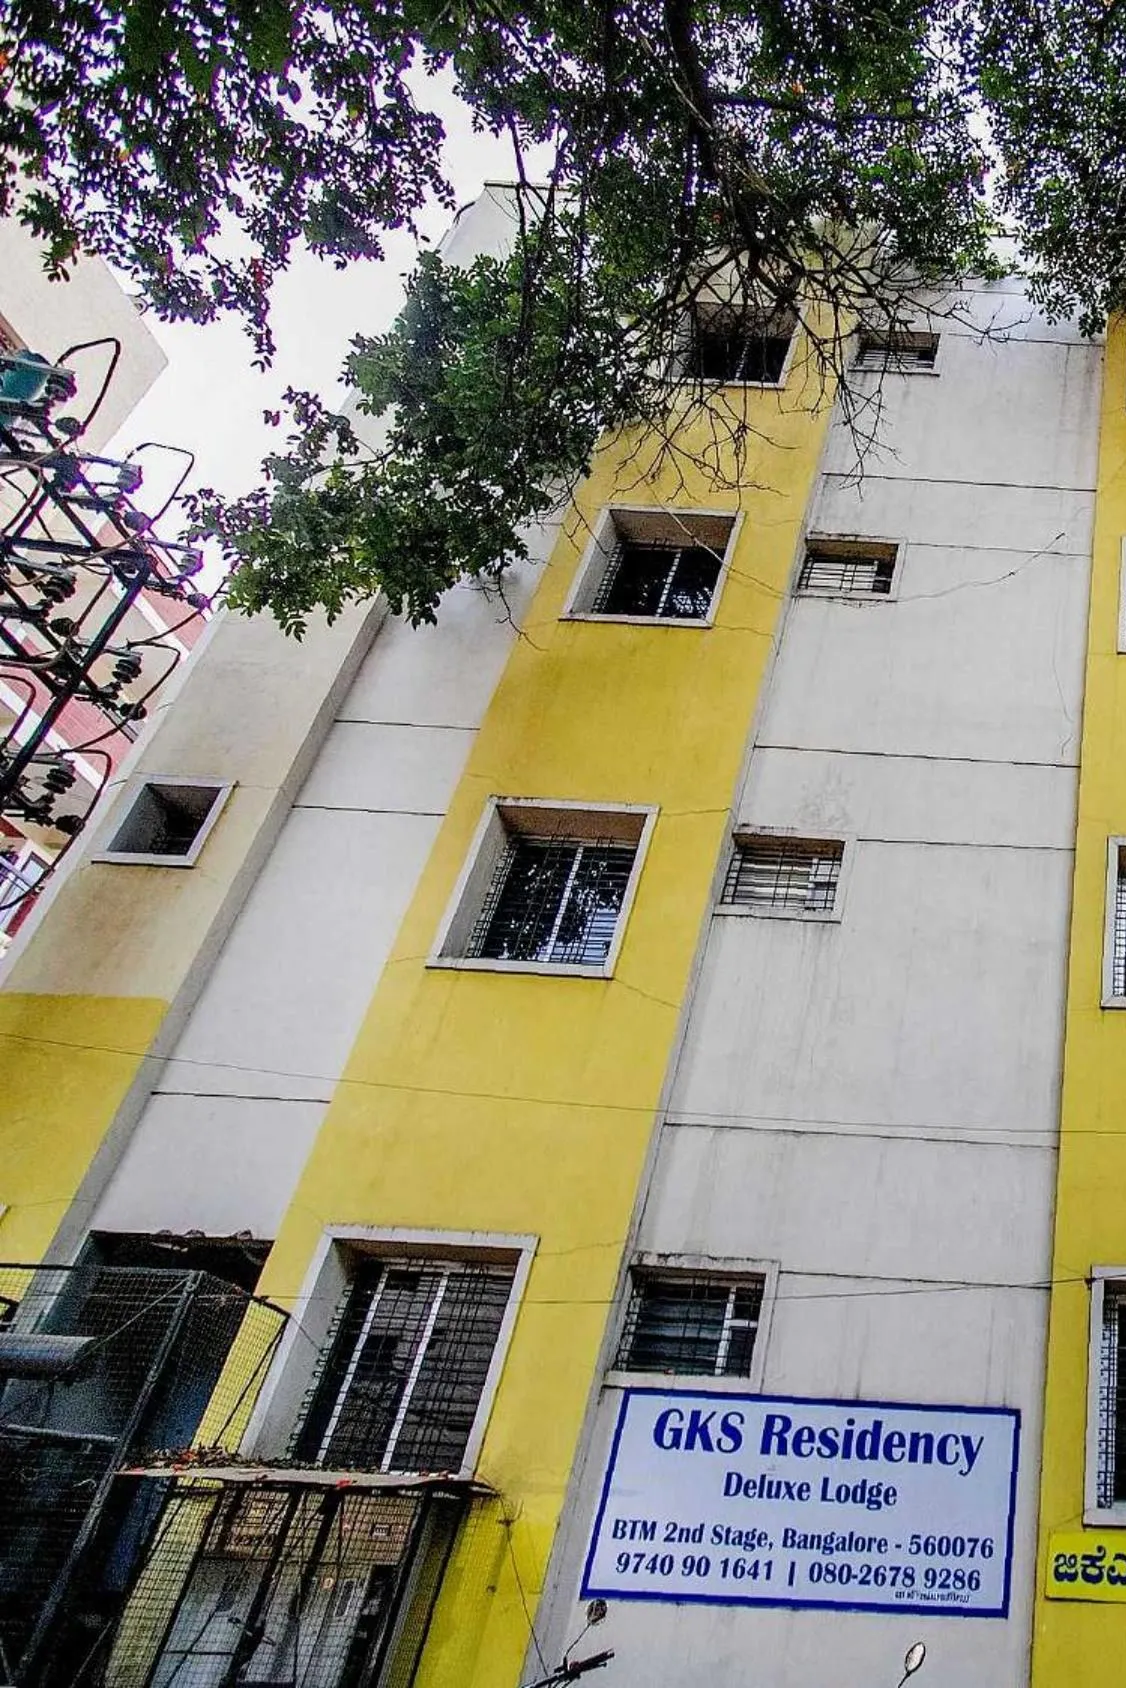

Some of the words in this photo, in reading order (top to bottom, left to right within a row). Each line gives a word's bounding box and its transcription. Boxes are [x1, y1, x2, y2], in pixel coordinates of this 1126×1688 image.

[653, 1408, 744, 1454] GKS
[761, 1413, 984, 1476] Residency
[723, 1471, 811, 1501] Deluxe
[821, 1477, 898, 1509] Lodge
[612, 1519, 657, 1541] BTM
[664, 1522, 704, 1544] 2nd
[710, 1524, 774, 1552] Stage,
[782, 1528, 888, 1555] Bangalore
[908, 1534, 994, 1558] 560076
[615, 1552, 674, 1576] 9740
[681, 1555, 711, 1578] 90
[719, 1557, 773, 1581] 1641
[808, 1562, 916, 1588] 080-2678
[922, 1567, 981, 1592] 9286
